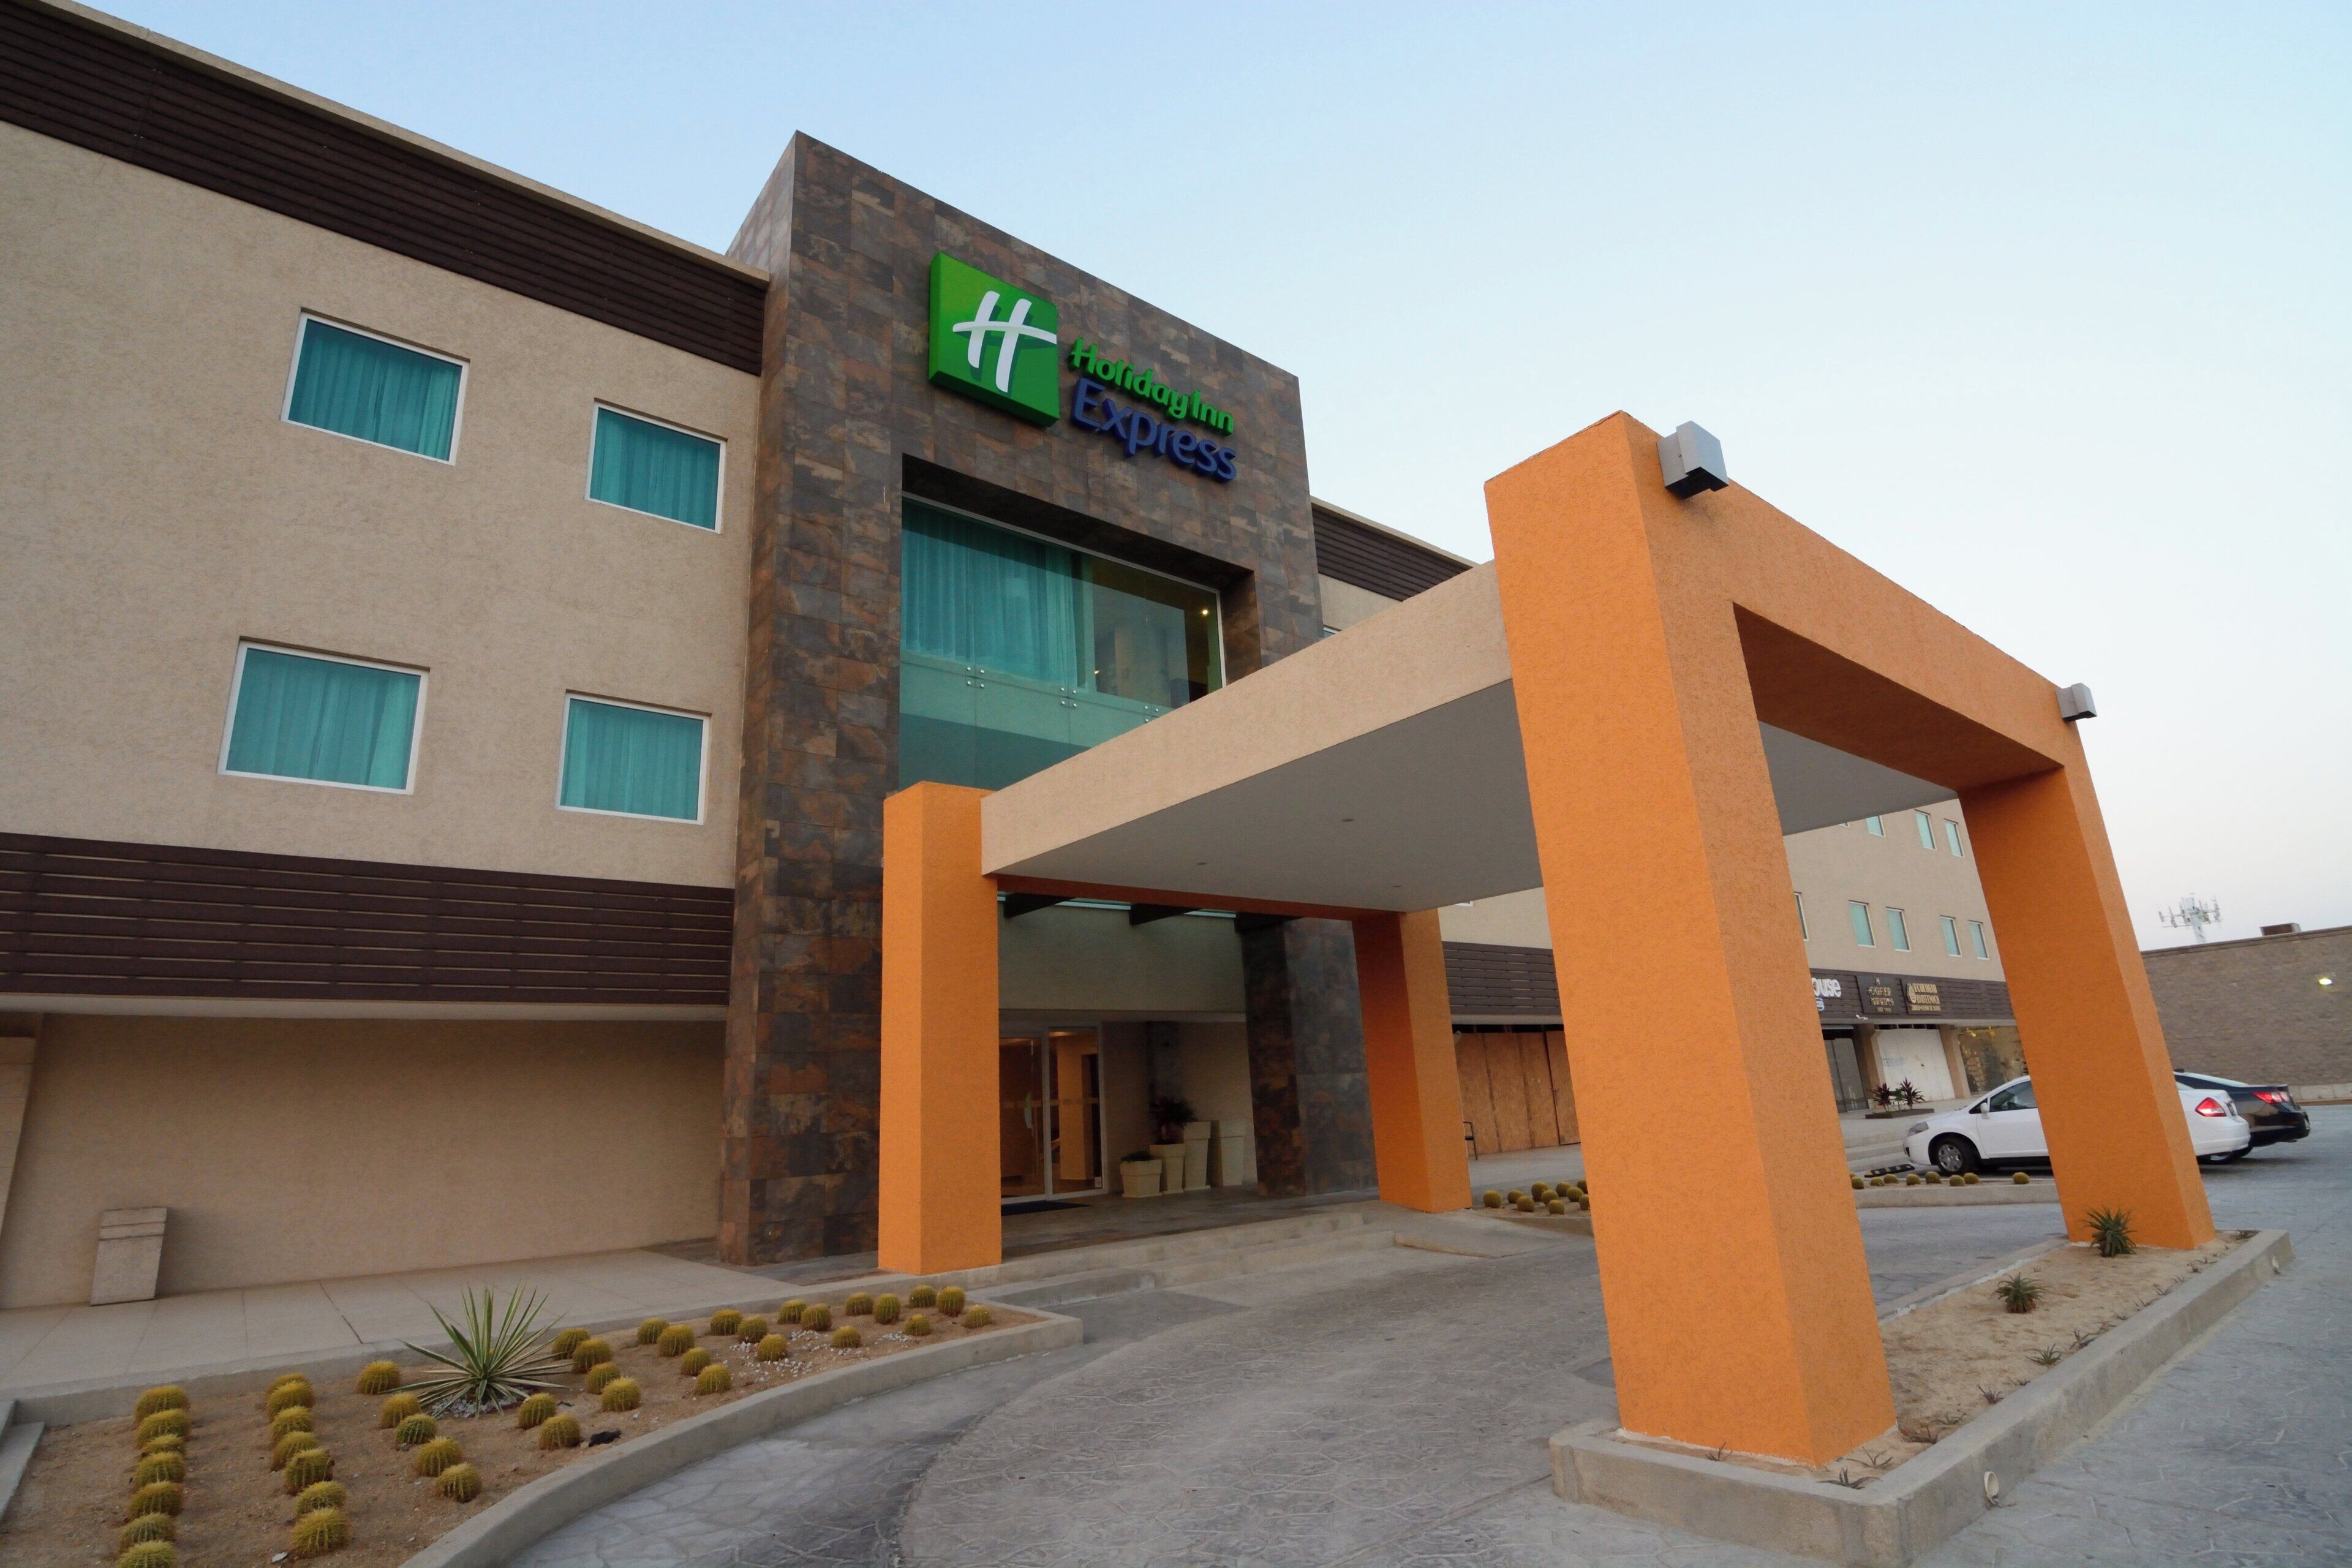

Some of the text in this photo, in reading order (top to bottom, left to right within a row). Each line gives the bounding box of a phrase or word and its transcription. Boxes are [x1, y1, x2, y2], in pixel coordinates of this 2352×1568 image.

[1070, 337, 1234, 435] Holiday Inn
[1071, 377, 1237, 483] Express
